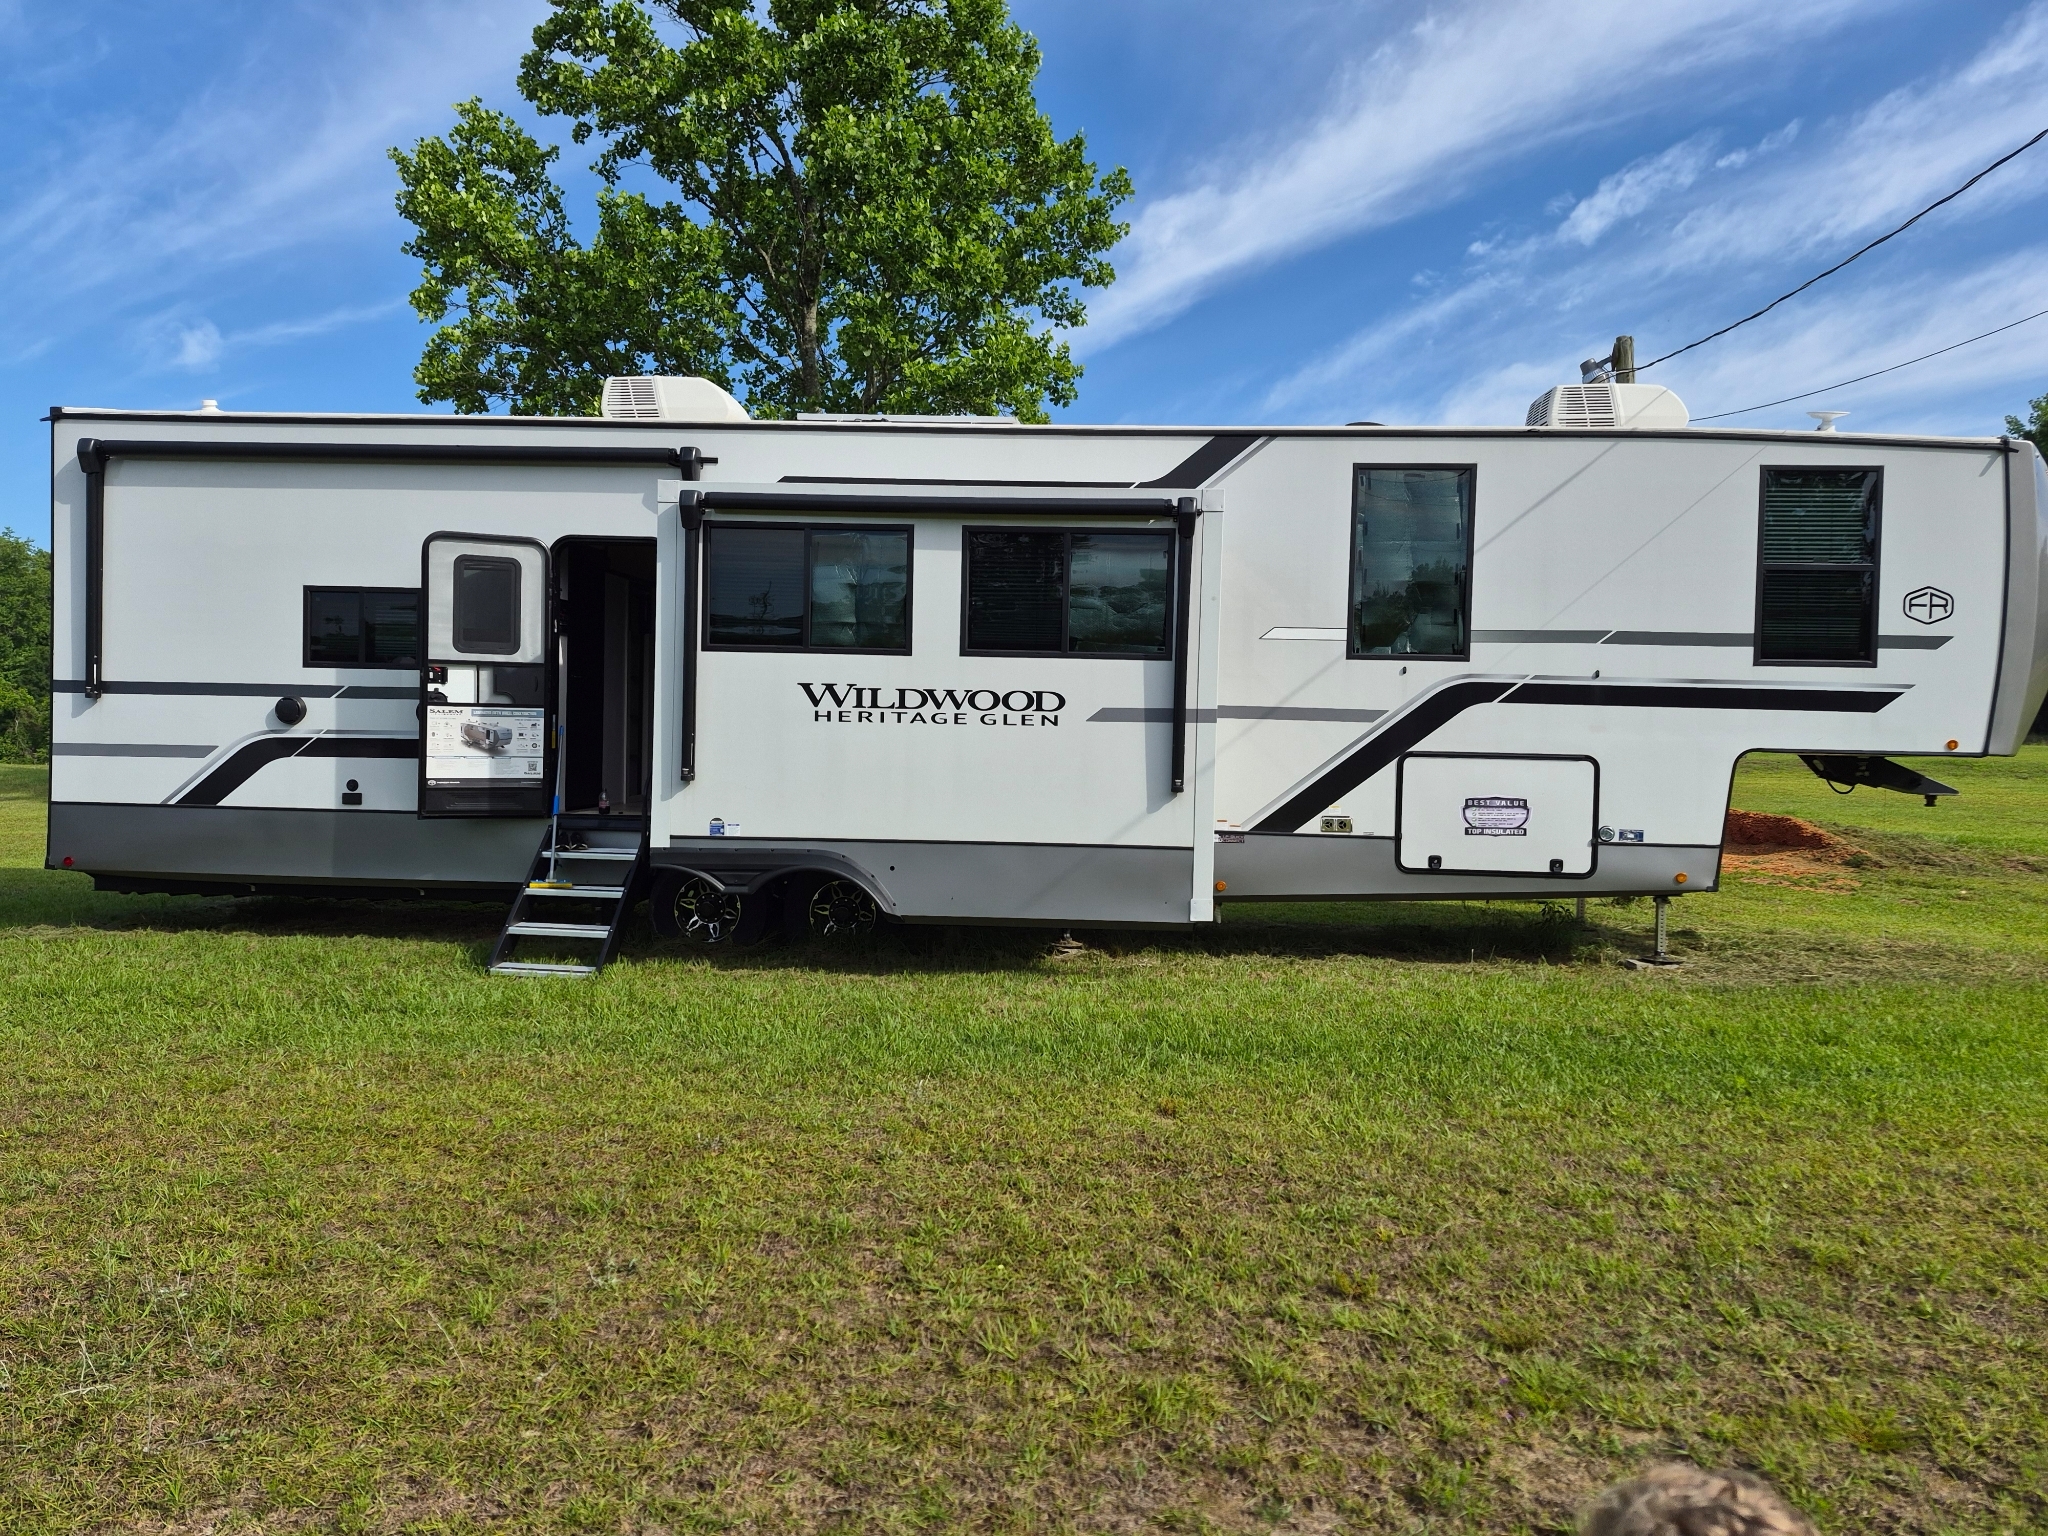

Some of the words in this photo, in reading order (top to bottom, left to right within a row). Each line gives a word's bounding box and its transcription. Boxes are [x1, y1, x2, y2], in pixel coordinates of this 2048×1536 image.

[797, 682, 1067, 712] WILDWOOD
[814, 710, 968, 725] HERITAGE
[979, 713, 1059, 727] GLEN
